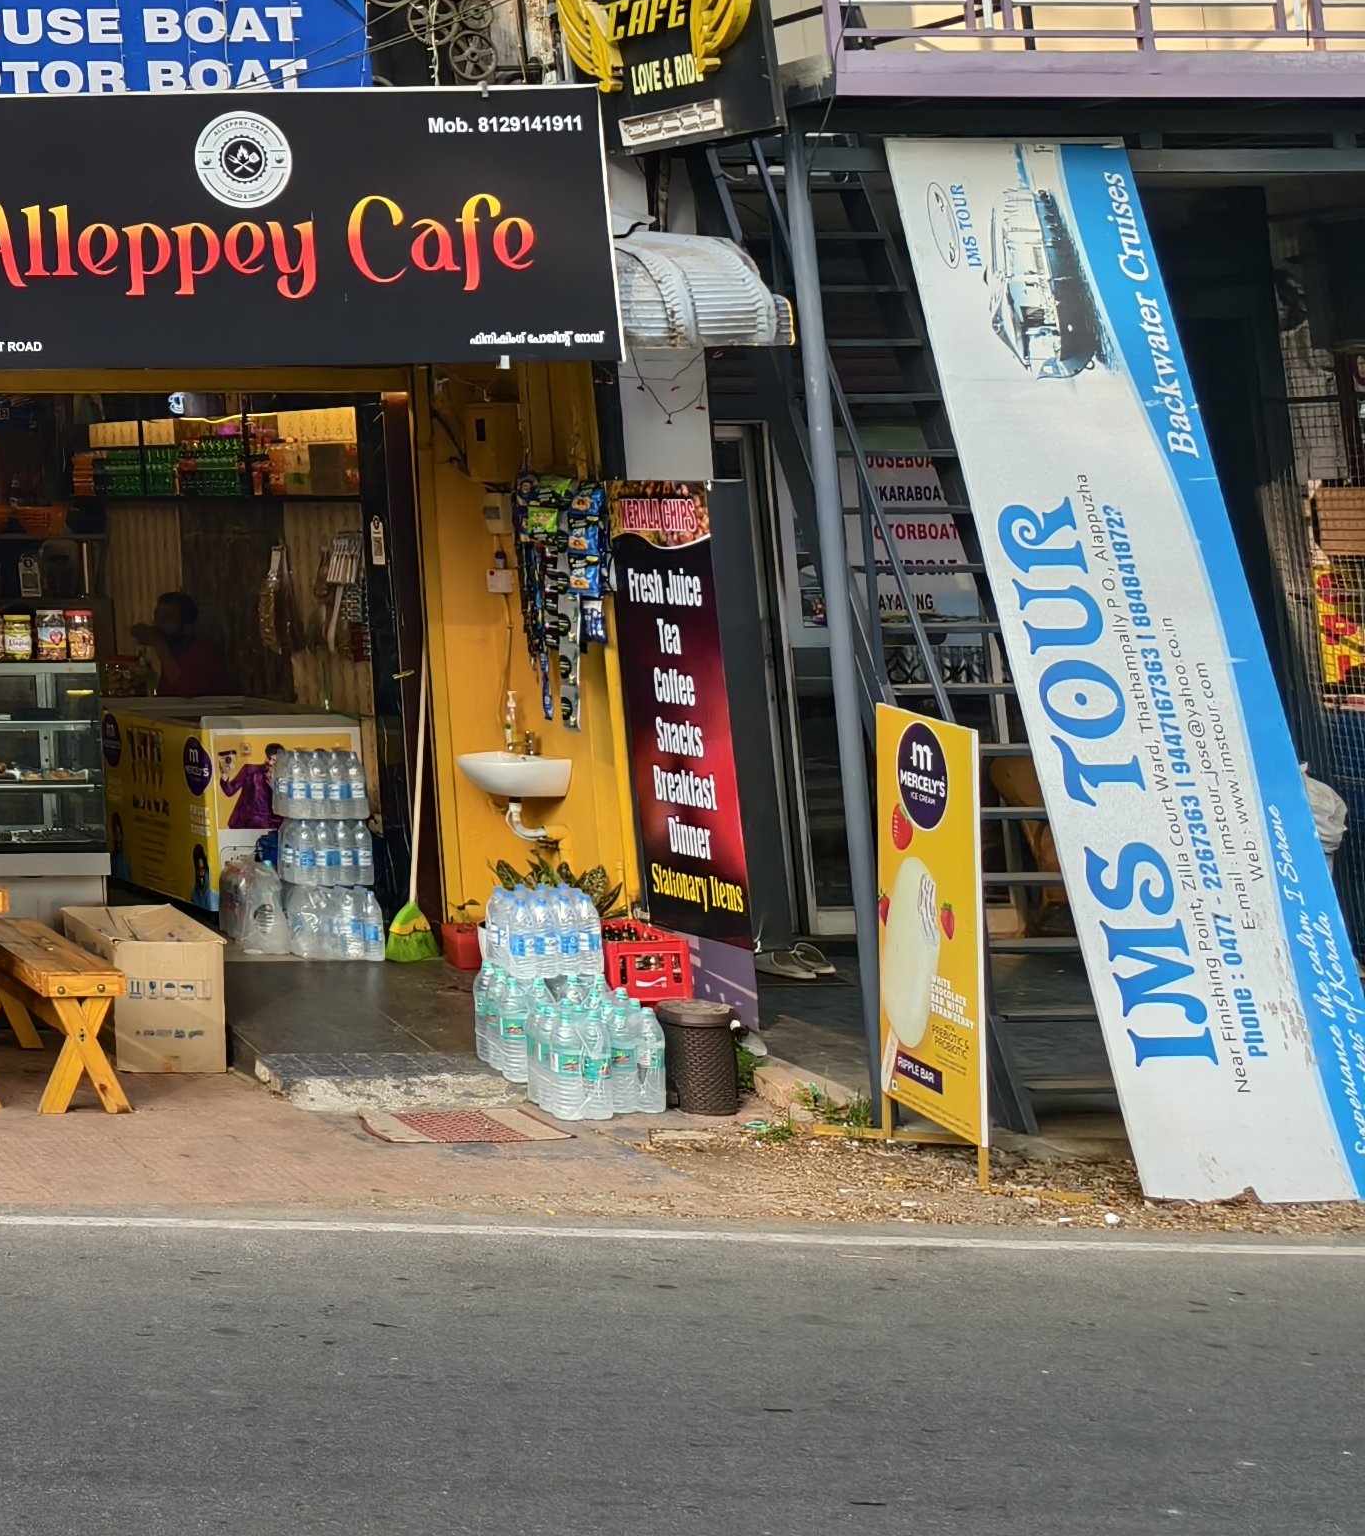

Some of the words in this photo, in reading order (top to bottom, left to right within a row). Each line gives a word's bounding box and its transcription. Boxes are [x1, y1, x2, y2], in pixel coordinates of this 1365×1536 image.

[143, 6, 303, 44] BOAT
[147, 59, 308, 93] BOAT
[631, 59, 662, 96] LOVE
[428, 116, 473, 133] Mob.
[477, 115, 583, 133] 8129141911
[950, 184, 973, 231] TOUR
[1103, 171, 1150, 282] Cruises
[347, 193, 535, 292] Cafe
[7, 341, 43, 352] ROAD
[1136, 292, 1200, 459] Backwater
[620, 497, 662, 532] KERALA
[628, 567, 664, 604] Fresh
[656, 618, 681, 655] Tea
[996, 495, 1147, 812] TOUR
[653, 666, 696, 707] Coffee
[655, 716, 704, 758] Snacks
[653, 764, 718, 811] Breakfast
[899, 769, 946, 798] MERCELY'S
[919, 793, 936, 805] CREAM
[668, 815, 712, 860] Dinner
[1268, 805, 1299, 877] Serene
[1246, 842, 1265, 882] Web
[709, 875, 744, 913] Items
[1235, 871, 1257, 931] E-mail
[1318, 911, 1361, 1002] Kerala
[930, 982, 967, 1007] CHOCOLATE
[1206, 957, 1236, 1051] Finishing
[930, 1001, 975, 1031] STRAWBERRY
[1234, 987, 1268, 1057] Phone
[920, 1066, 936, 1085] BAR
